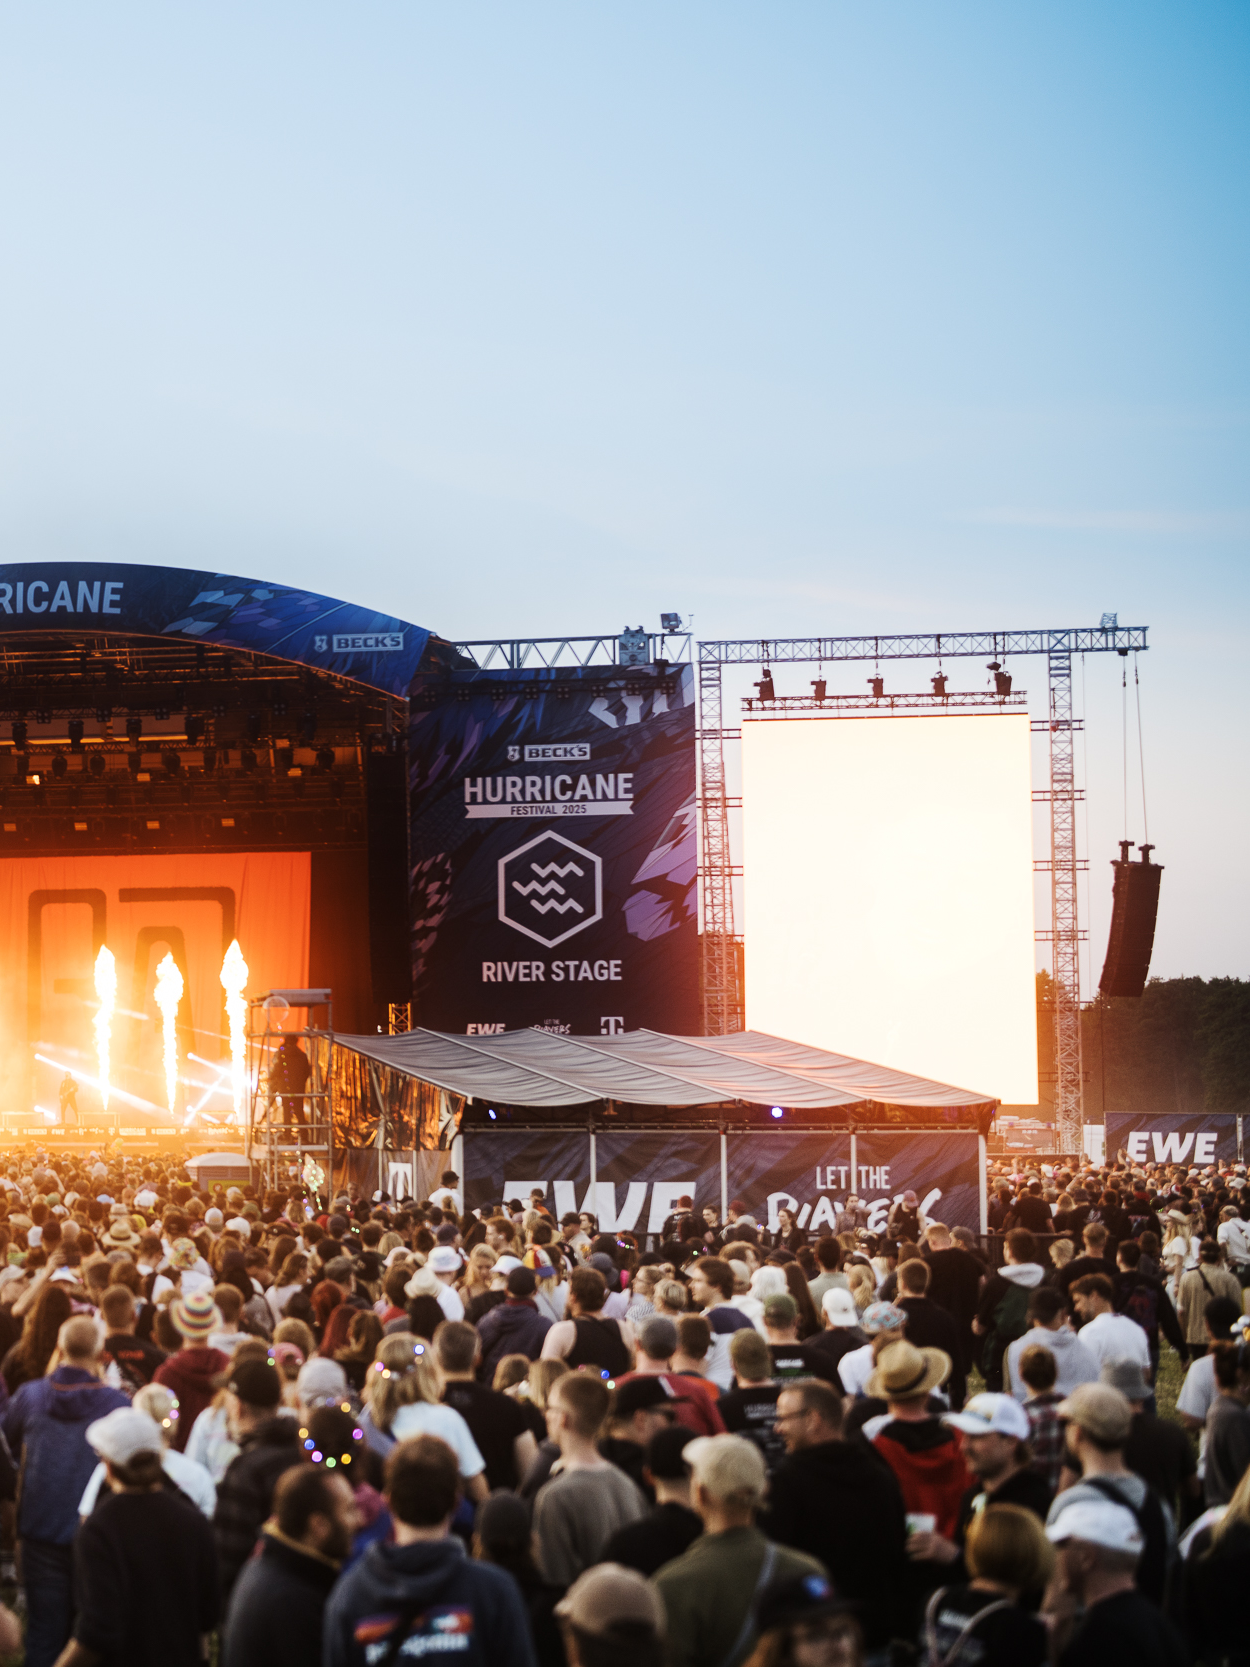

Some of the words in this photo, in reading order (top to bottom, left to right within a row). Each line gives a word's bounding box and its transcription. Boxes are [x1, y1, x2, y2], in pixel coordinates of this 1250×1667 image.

[335, 633, 402, 650] BECK'S
[526, 744, 588, 760] BECK'S
[464, 773, 634, 802] HURRICANE
[511, 805, 557, 816] FESTIVAL
[562, 804, 587, 815] 2025
[482, 961, 545, 982] RIVER
[551, 960, 622, 981] STAGE
[1125, 1131, 1218, 1164] EWE
[816, 1166, 849, 1189] LET
[858, 1166, 891, 1189] THE
